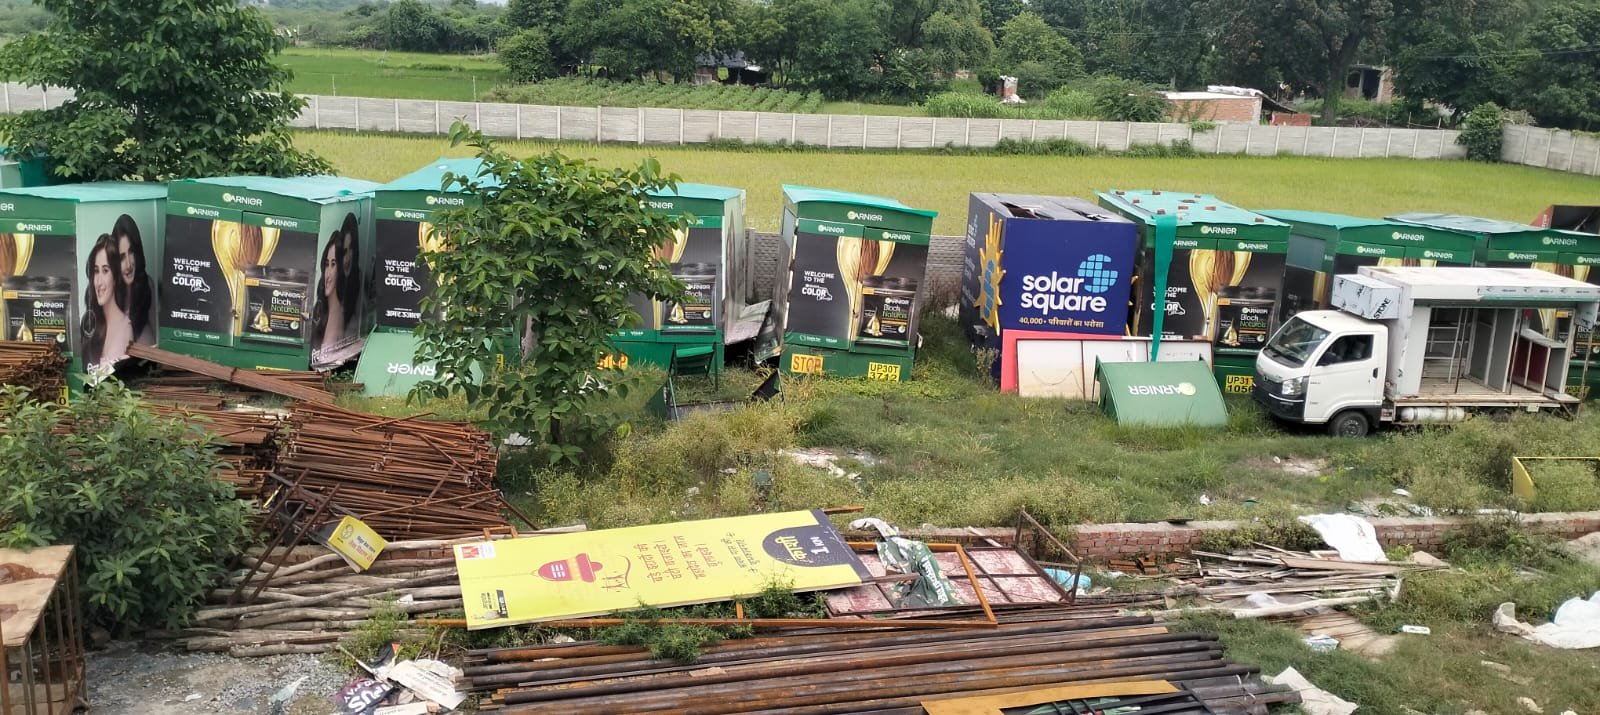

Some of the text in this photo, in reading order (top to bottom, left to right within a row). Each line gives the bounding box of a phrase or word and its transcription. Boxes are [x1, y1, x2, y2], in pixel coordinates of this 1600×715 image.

[222, 193, 263, 206] GARNIER
[426, 196, 464, 205] GARNIER
[187, 207, 219, 217] GARNIER
[395, 211, 424, 219] GARNIER
[848, 211, 882, 221] GARNIER
[16, 223, 52, 231] GARNIER
[265, 218, 298, 228] GARNIER
[818, 225, 844, 233] GARNIER
[1201, 226, 1237, 234] GARNIER
[882, 232, 911, 240] GARNIER
[1392, 232, 1424, 241] GARNIER
[1543, 236, 1577, 245] GARNIER
[1238, 242, 1268, 250] GARNIER
[1357, 246, 1385, 255] GARNIER
[1424, 250, 1453, 259] GARNIER
[1508, 252, 1537, 260] GARNIER
[174, 258, 211, 268] WELCOME
[172, 276, 202, 288] COLOR
[385, 278, 412, 287] COLOR
[1022, 271, 1084, 293] solar
[802, 287, 826, 296] COLOR
[1020, 292, 1106, 315] square
[793, 356, 821, 372] STOP
[870, 364, 898, 373] UP30T
[1128, 382, 1196, 396] GARNIER
[774, 536, 808, 562] काशी
[811, 546, 830, 556] 1
